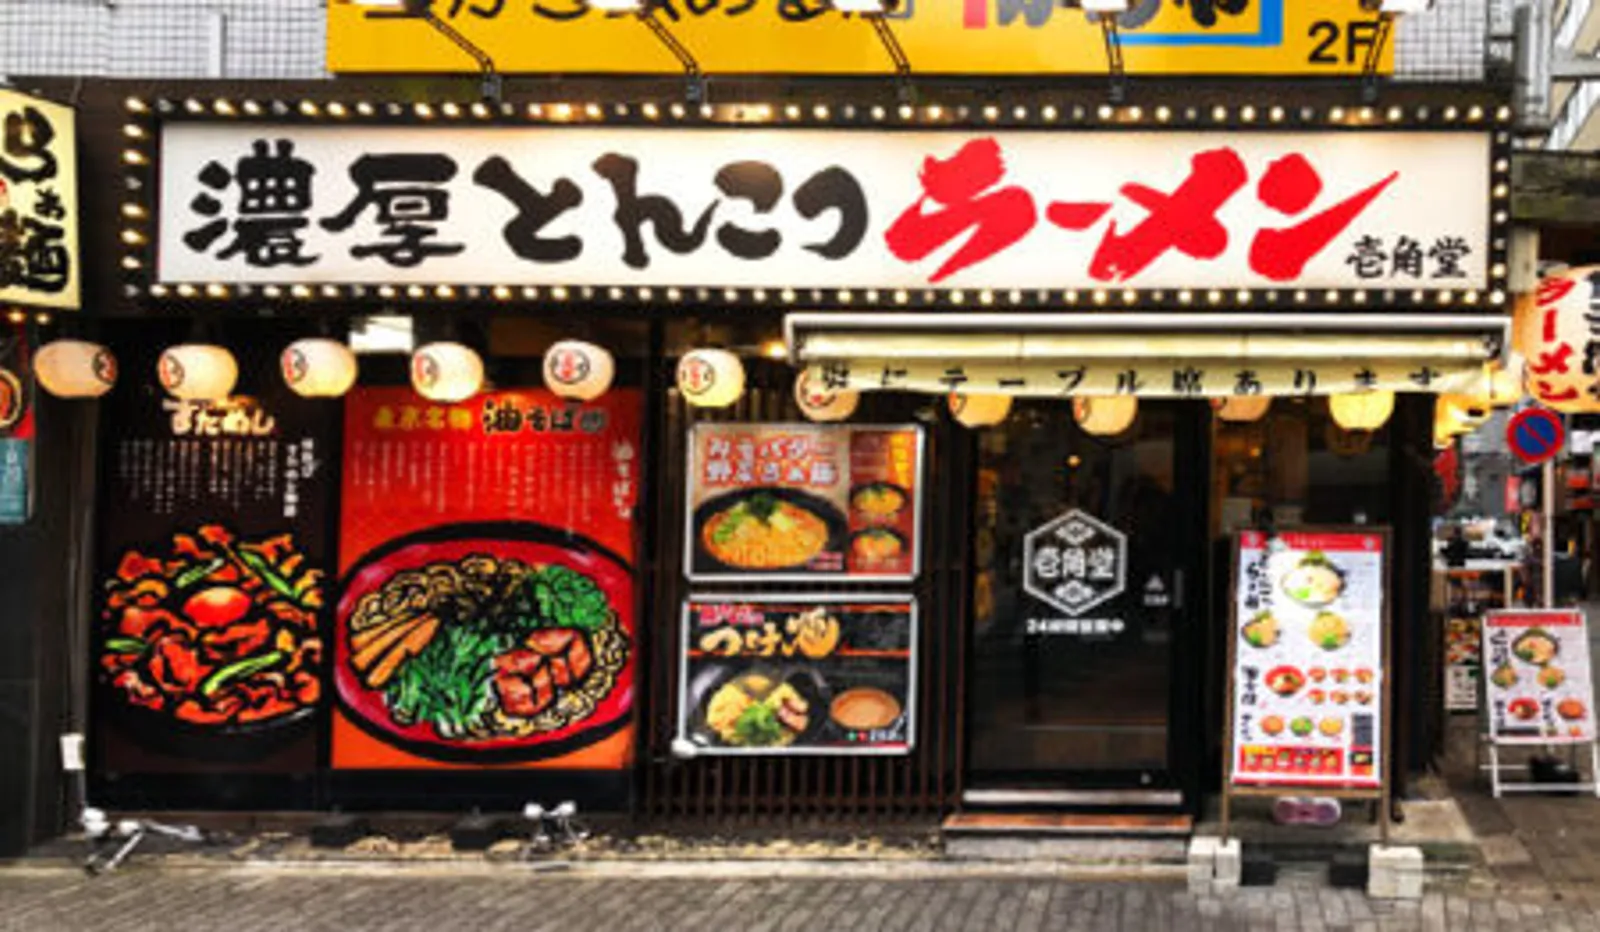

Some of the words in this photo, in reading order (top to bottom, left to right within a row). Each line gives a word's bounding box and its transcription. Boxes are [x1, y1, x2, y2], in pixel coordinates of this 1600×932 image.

[1308, 21, 1379, 64] 2F
[183, 137, 1399, 283] 濃厚とんこつラーメン
[1346, 236, 1472, 280] 壱角堂
[1529, 275, 1577, 402] ラーメン
